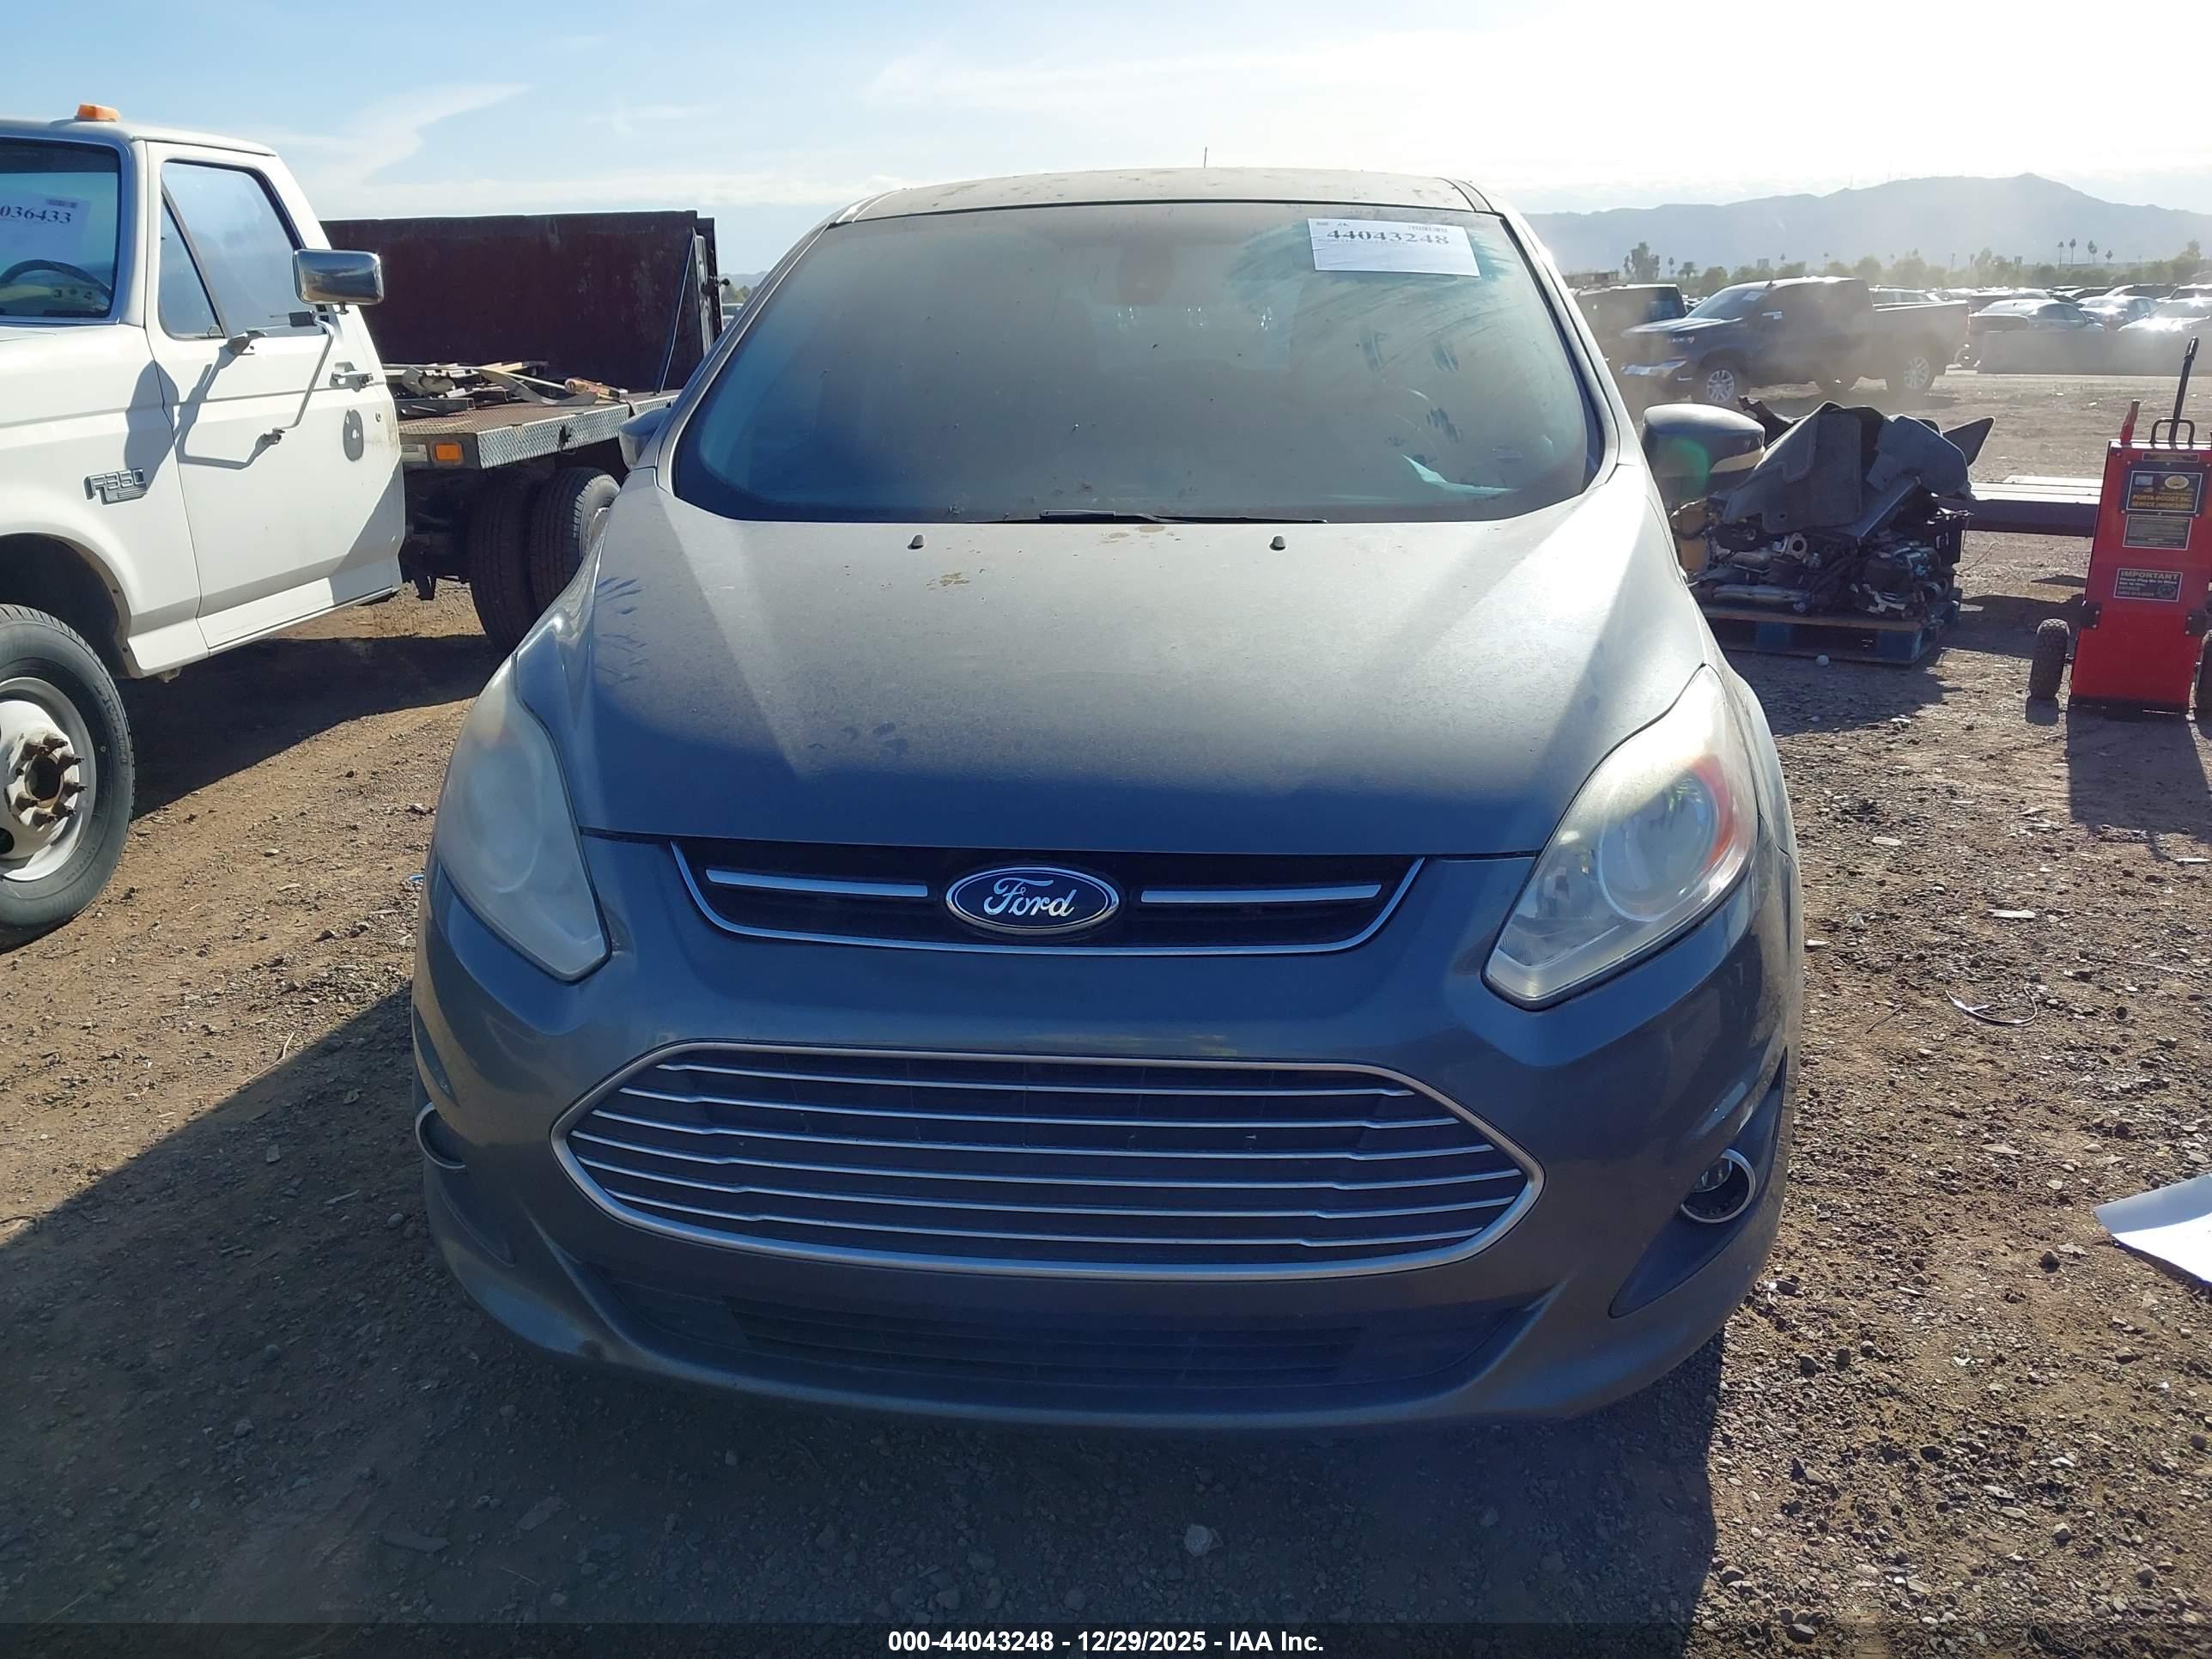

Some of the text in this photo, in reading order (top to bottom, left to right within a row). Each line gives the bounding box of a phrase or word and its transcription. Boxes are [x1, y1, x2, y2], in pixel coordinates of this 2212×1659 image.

[0, 205, 72, 224] 036433
[1327, 229, 1449, 244] 44043248
[84, 468, 147, 505] F350
[2120, 570, 2179, 580] IMPORTANT
[983, 877, 1078, 917] Ford
